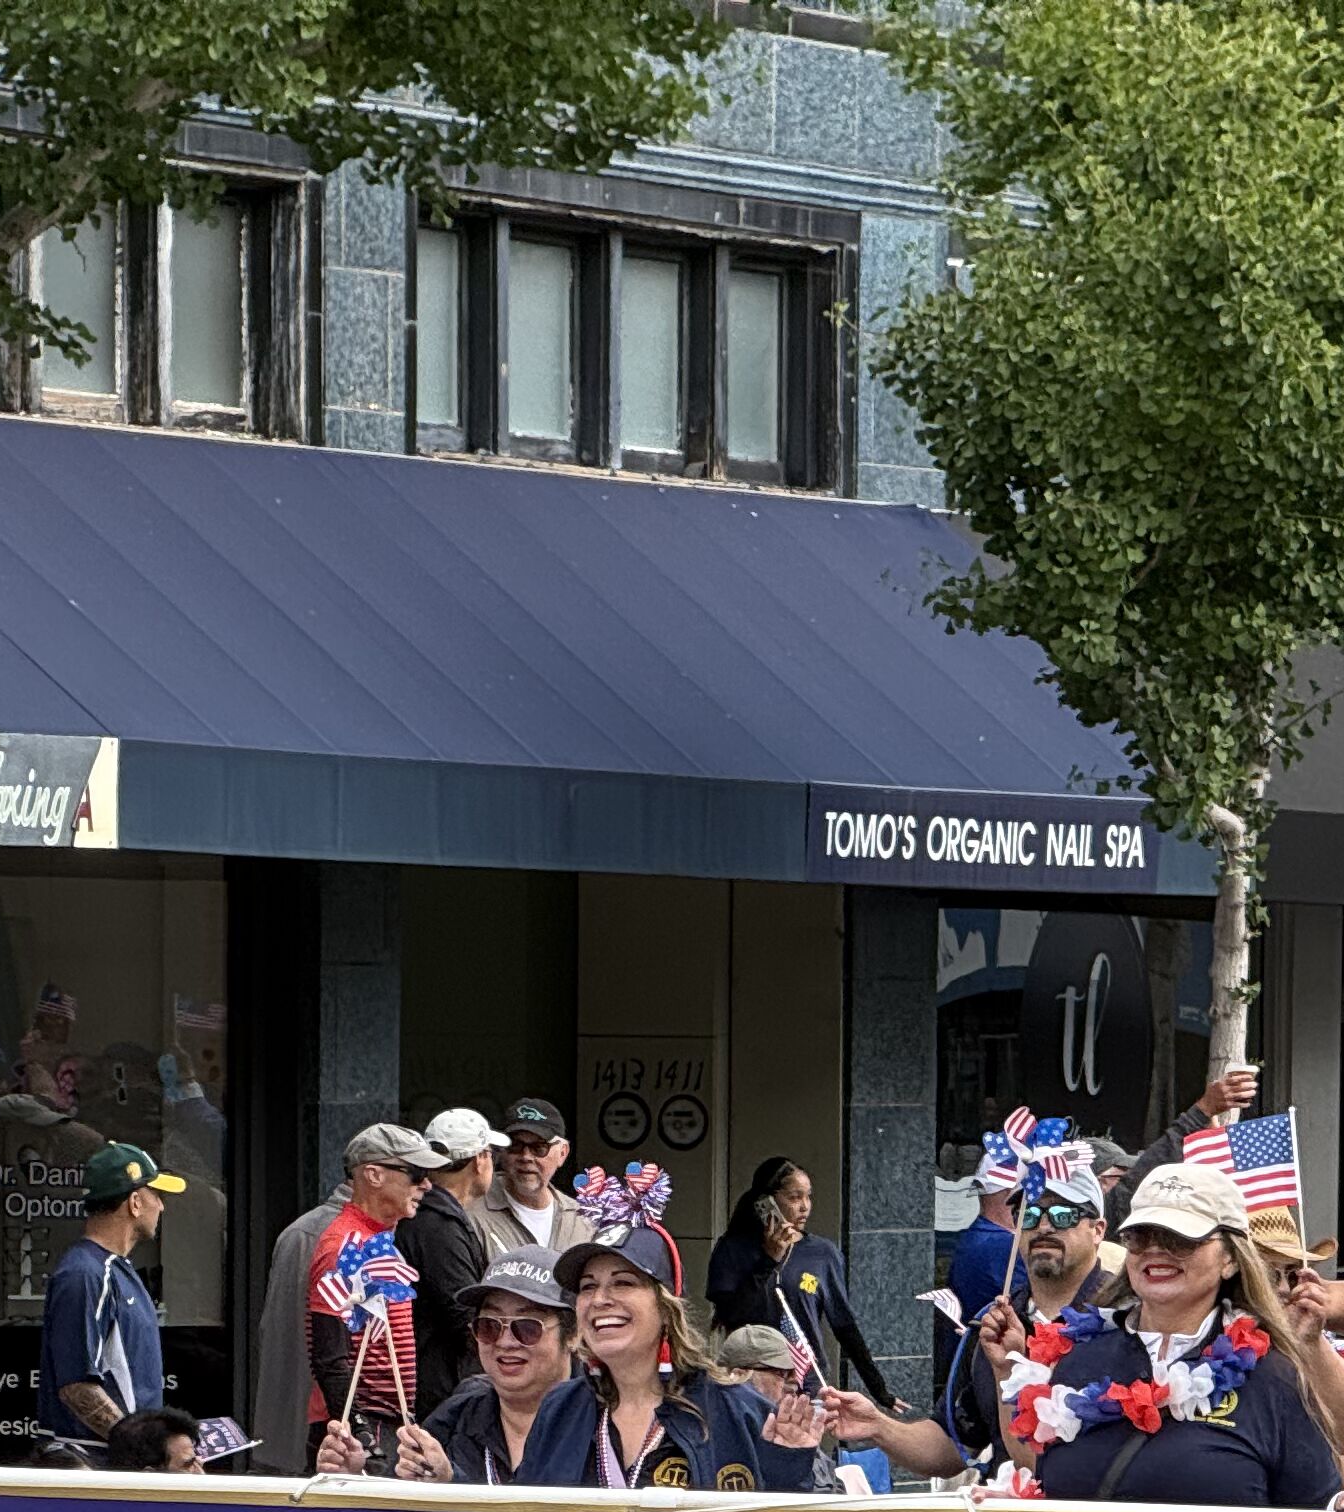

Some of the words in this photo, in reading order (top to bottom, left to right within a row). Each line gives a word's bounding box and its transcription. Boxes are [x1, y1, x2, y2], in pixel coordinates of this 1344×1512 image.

[824, 811, 917, 860] TOMO'S
[926, 816, 1038, 867] ORGANIC
[1046, 823, 1095, 868] NAIL
[1105, 825, 1145, 869] SPA
[592, 1059, 645, 1092] 1413
[654, 1060, 705, 1092] 1411
[29, 1160, 87, 1187] Dani
[6, 1192, 90, 1222] Optom
